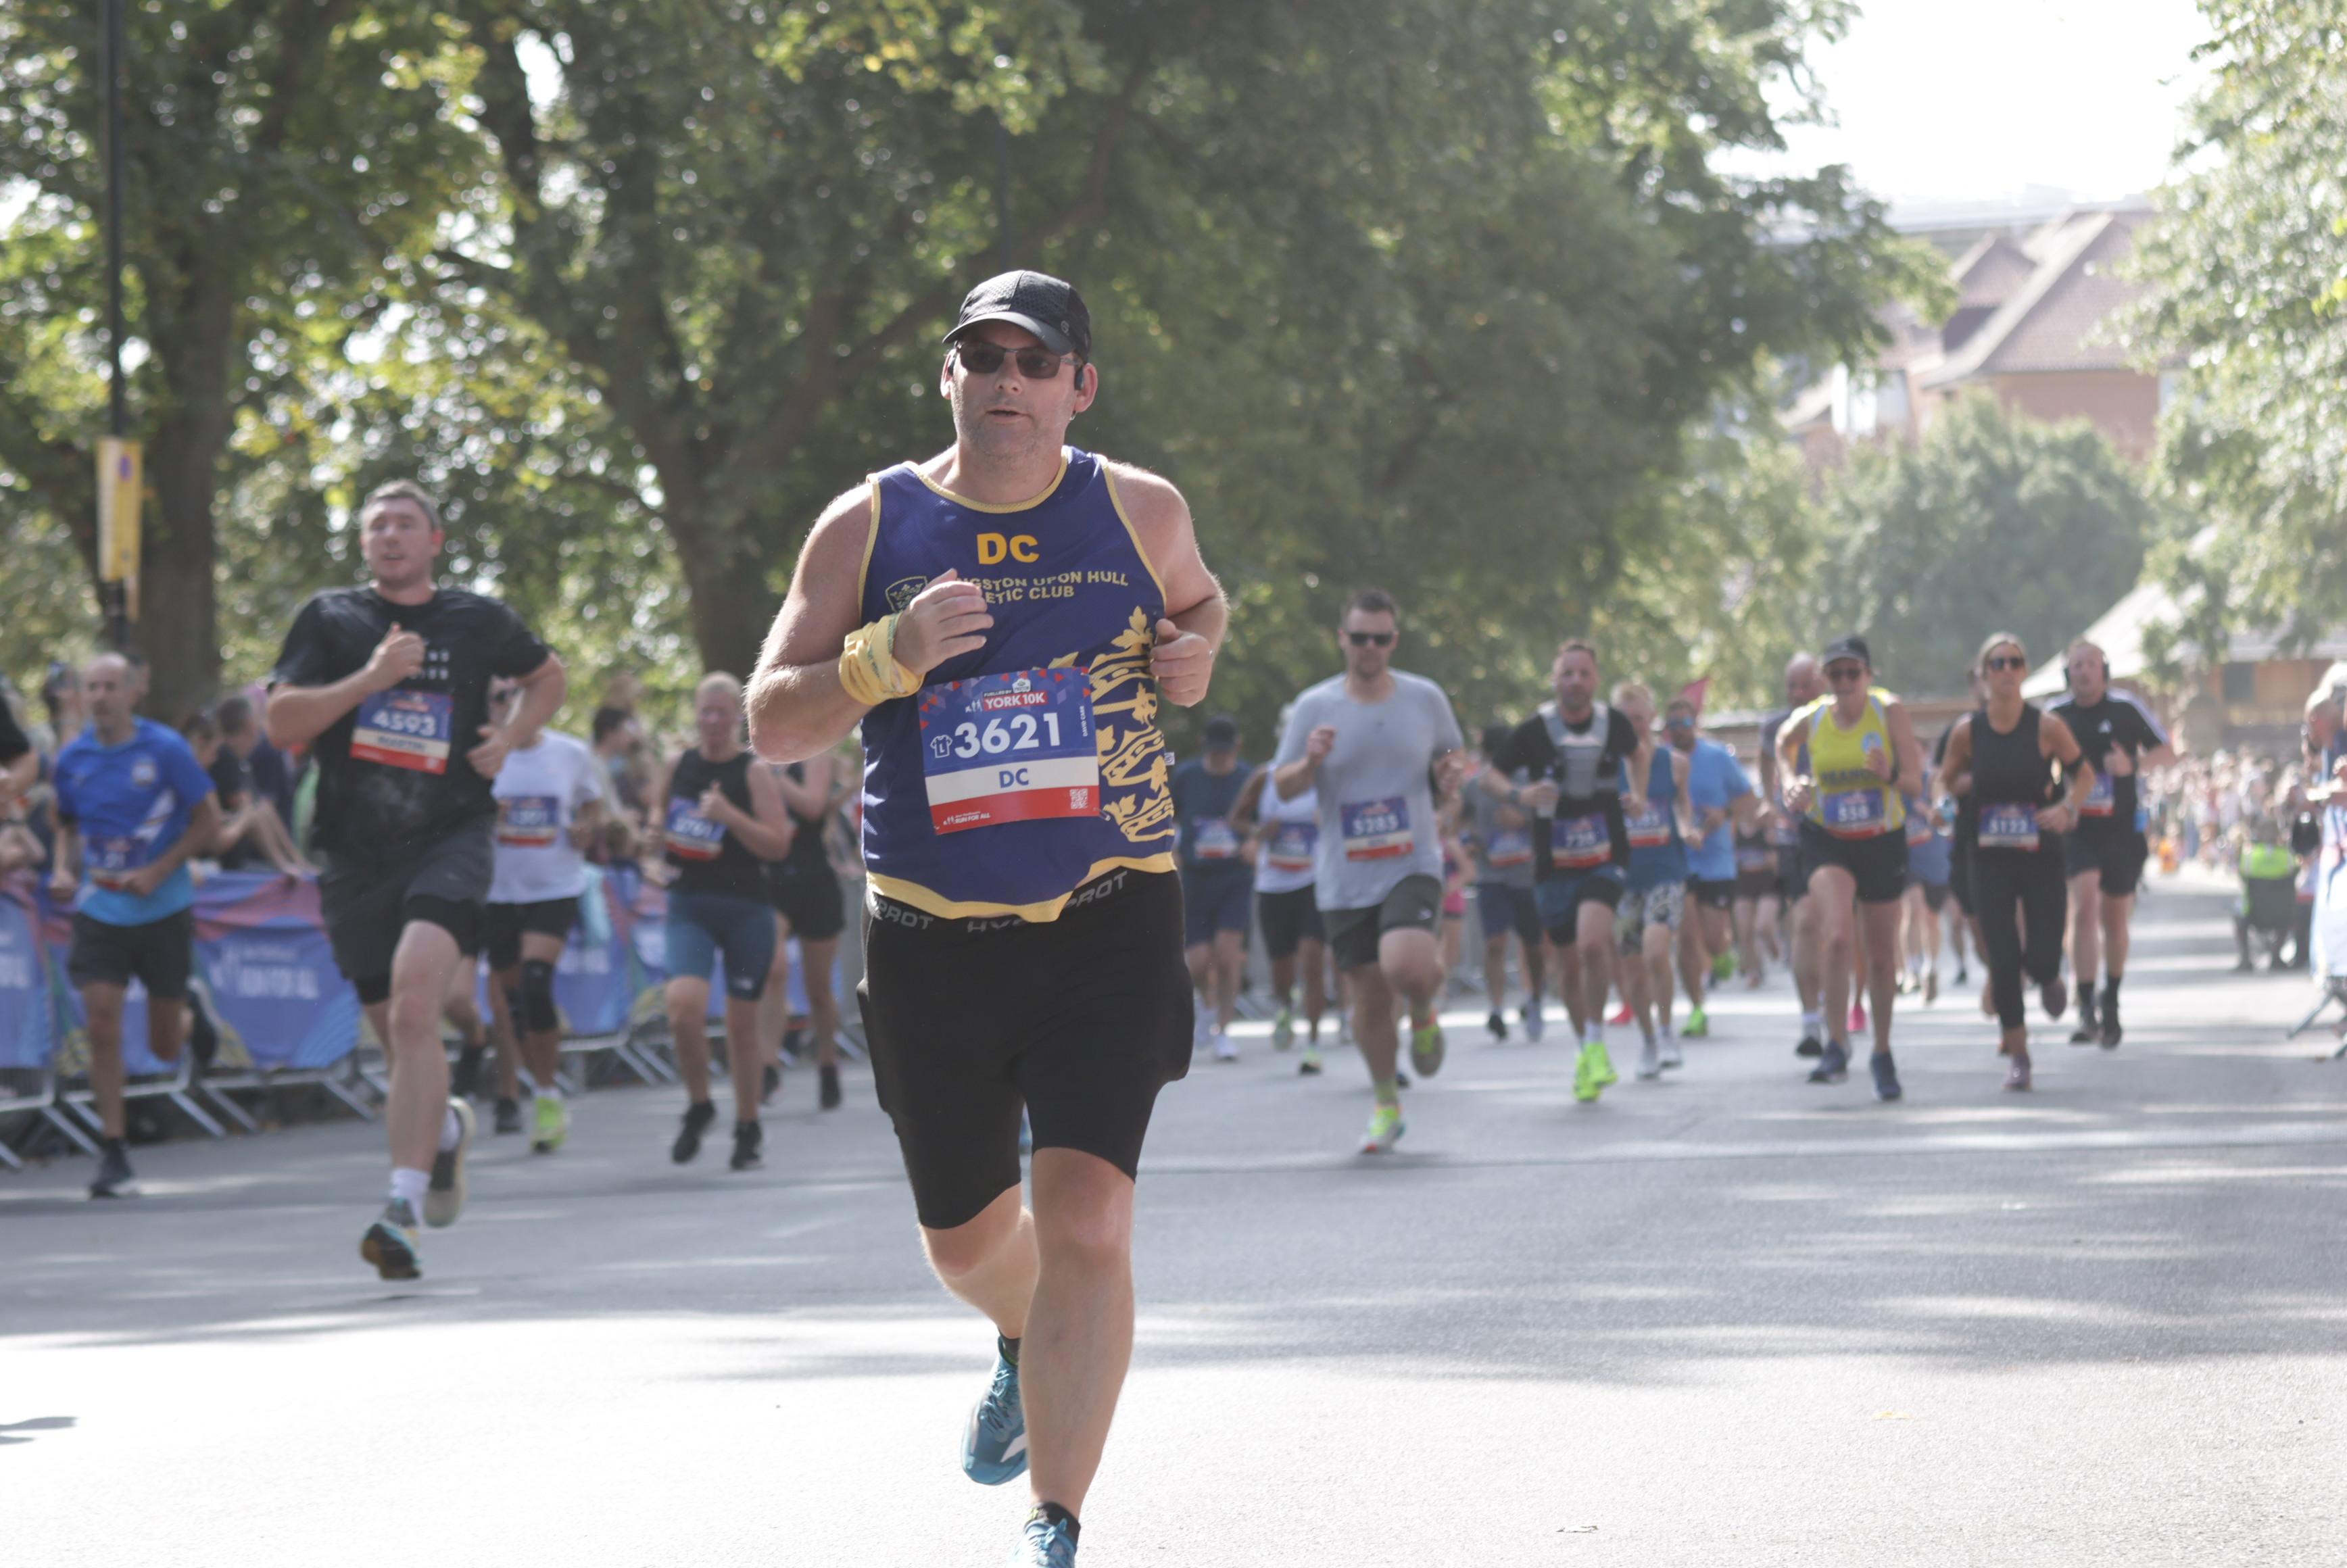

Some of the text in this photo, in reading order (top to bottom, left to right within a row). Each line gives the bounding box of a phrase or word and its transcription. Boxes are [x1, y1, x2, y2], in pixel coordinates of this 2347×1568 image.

[977, 533, 1039, 564] DC
[1034, 571, 1082, 586] UPON
[1088, 571, 1129, 586] HULL
[985, 585, 1074, 604] ETIC CLUB
[986, 692, 1045, 709] YORK 10K
[954, 712, 1060, 758] 3621
[939, 743, 945, 753] L
[999, 768, 1029, 788] DC
